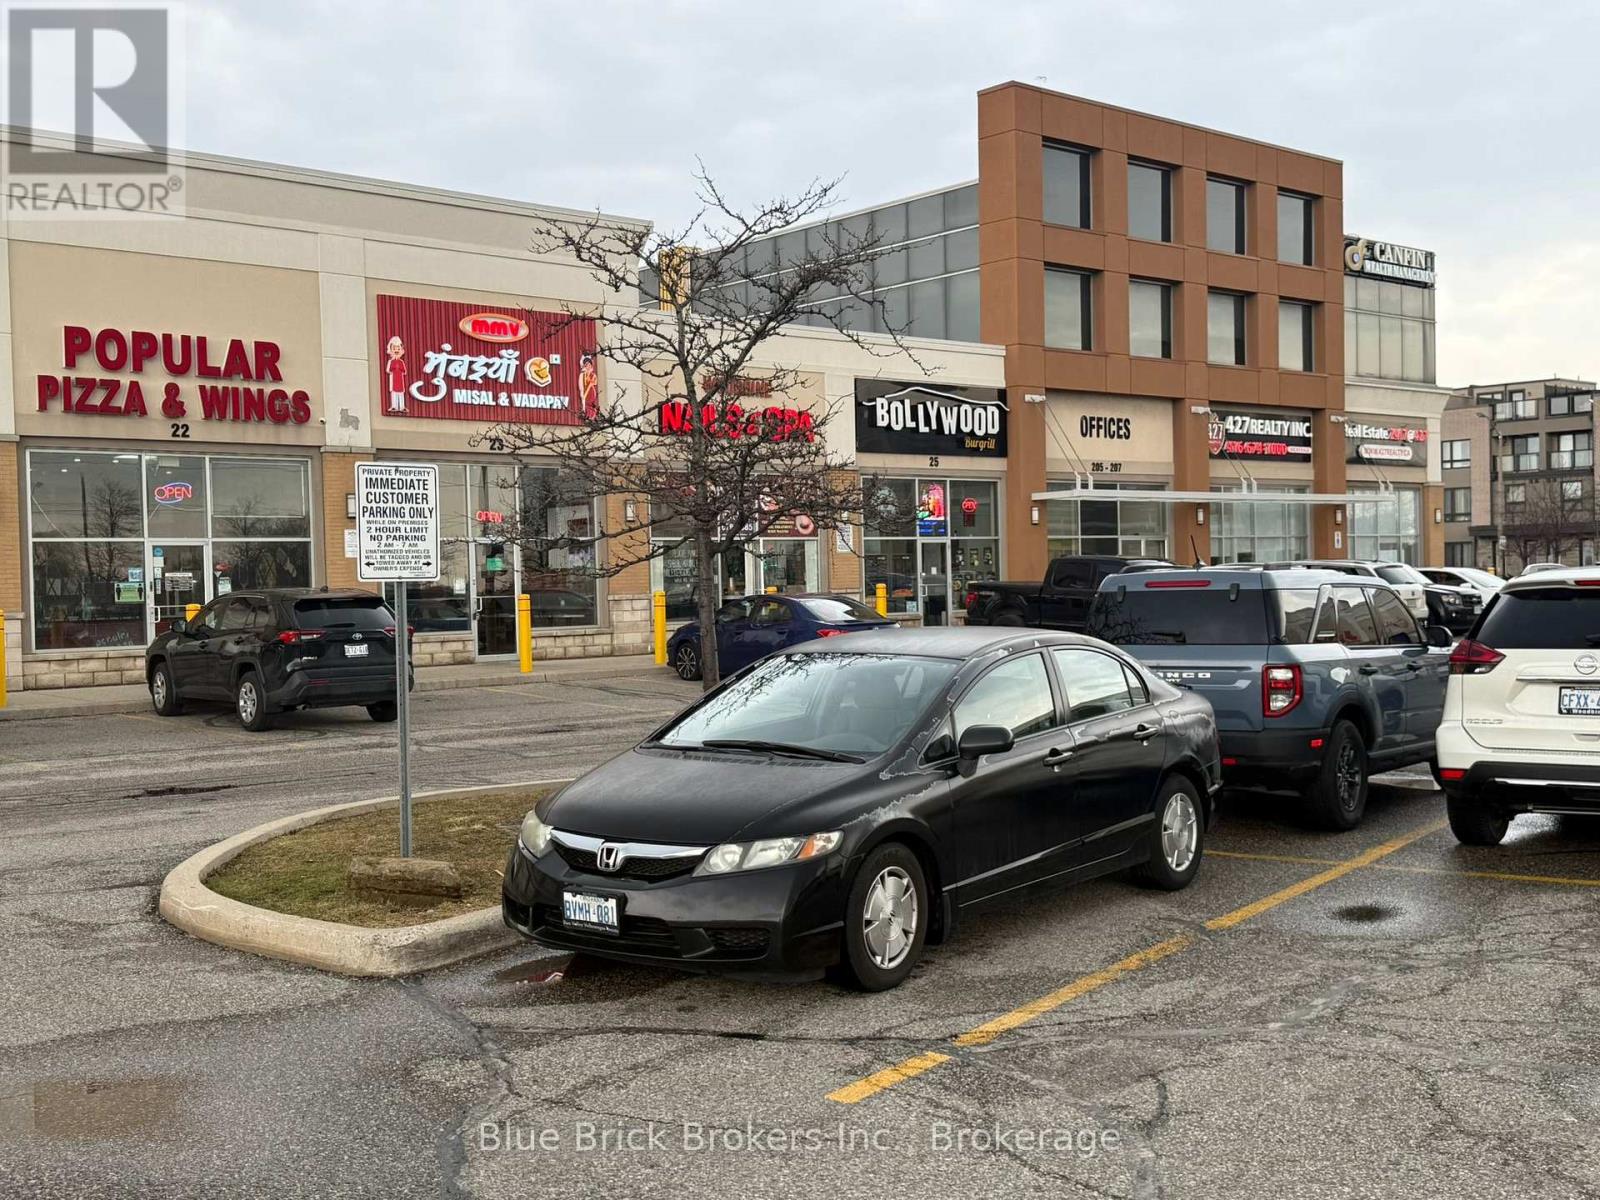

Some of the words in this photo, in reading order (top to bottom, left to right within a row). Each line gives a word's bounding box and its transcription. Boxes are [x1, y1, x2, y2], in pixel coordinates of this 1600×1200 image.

[1374, 242, 1426, 269] CANFIN
[62, 325, 283, 382] POPULAR
[36, 374, 147, 416] PIZZA
[161, 382, 187, 417] &
[198, 384, 311, 424] WINGS
[454, 389, 495, 406] MISAL
[499, 392, 510, 406] &
[876, 397, 1000, 436] BOLLYWOOD
[171, 423, 190, 438] 22
[1080, 415, 1130, 440] OFFICES
[490, 439, 504, 451] 23
[929, 457, 939, 467] 25
[1092, 463, 1103, 471] 205
[394, 469, 430, 477] PROPERTY
[365, 477, 428, 490] IMMEDIATE
[154, 486, 192, 498] OPEN
[366, 492, 428, 504] CUSTOMER
[362, 506, 405, 518] PARKING
[409, 507, 434, 519] ONLY
[475, 511, 504, 523] OPEN
